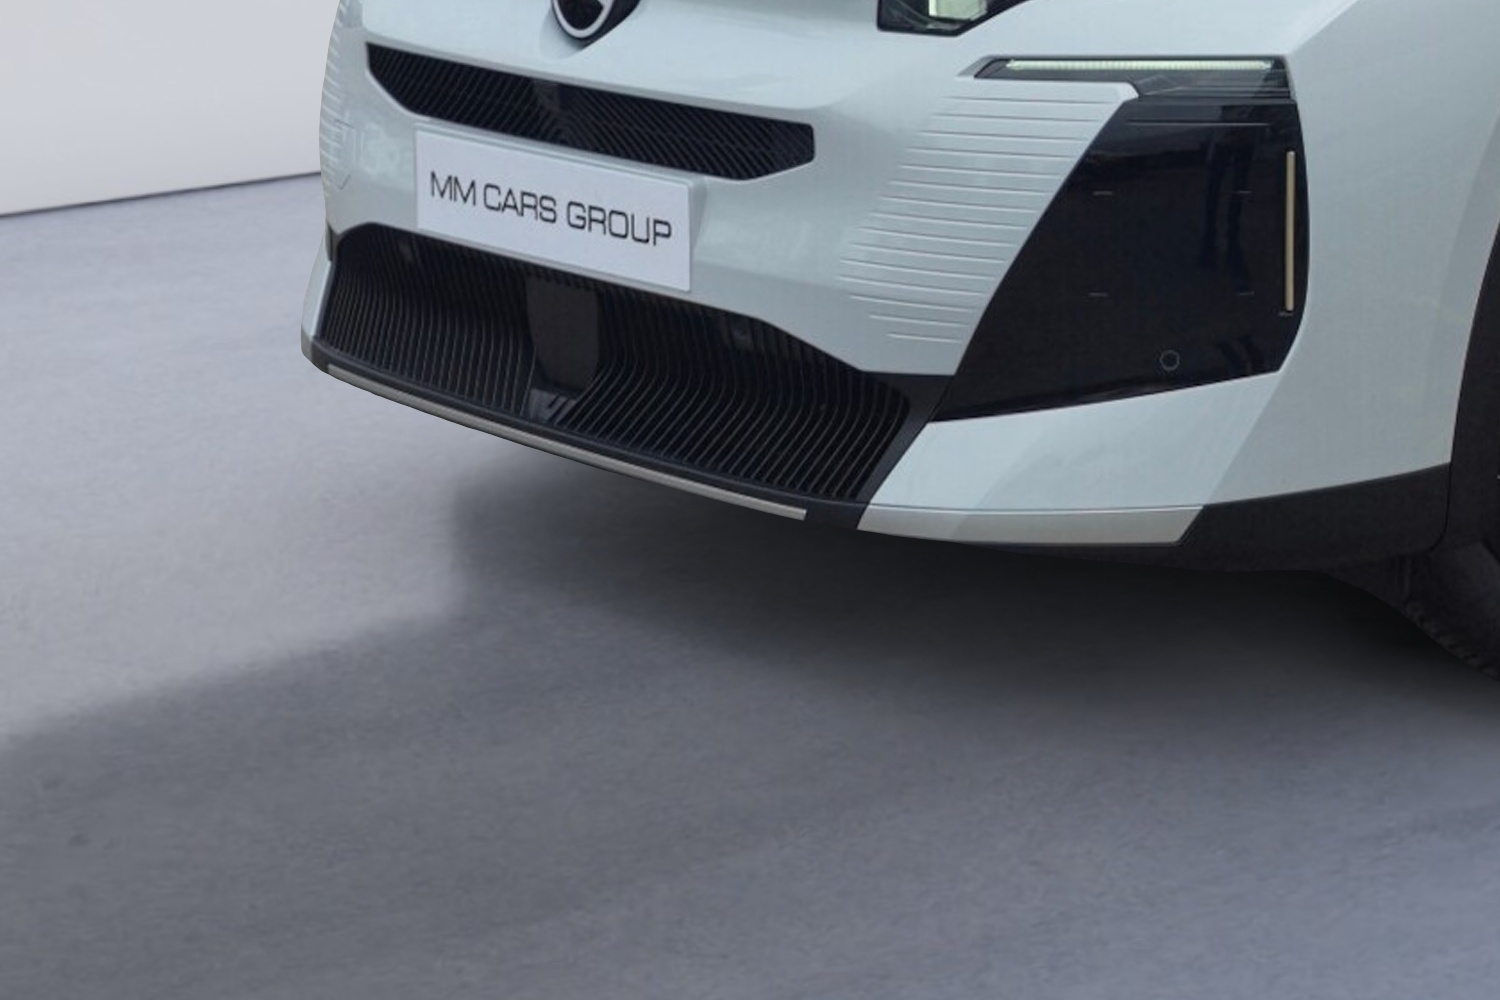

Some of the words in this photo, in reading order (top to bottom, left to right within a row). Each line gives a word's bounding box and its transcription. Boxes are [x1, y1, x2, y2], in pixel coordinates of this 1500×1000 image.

[430, 171, 476, 206] MM
[482, 183, 557, 224] CARS
[566, 201, 672, 247] GROUP
